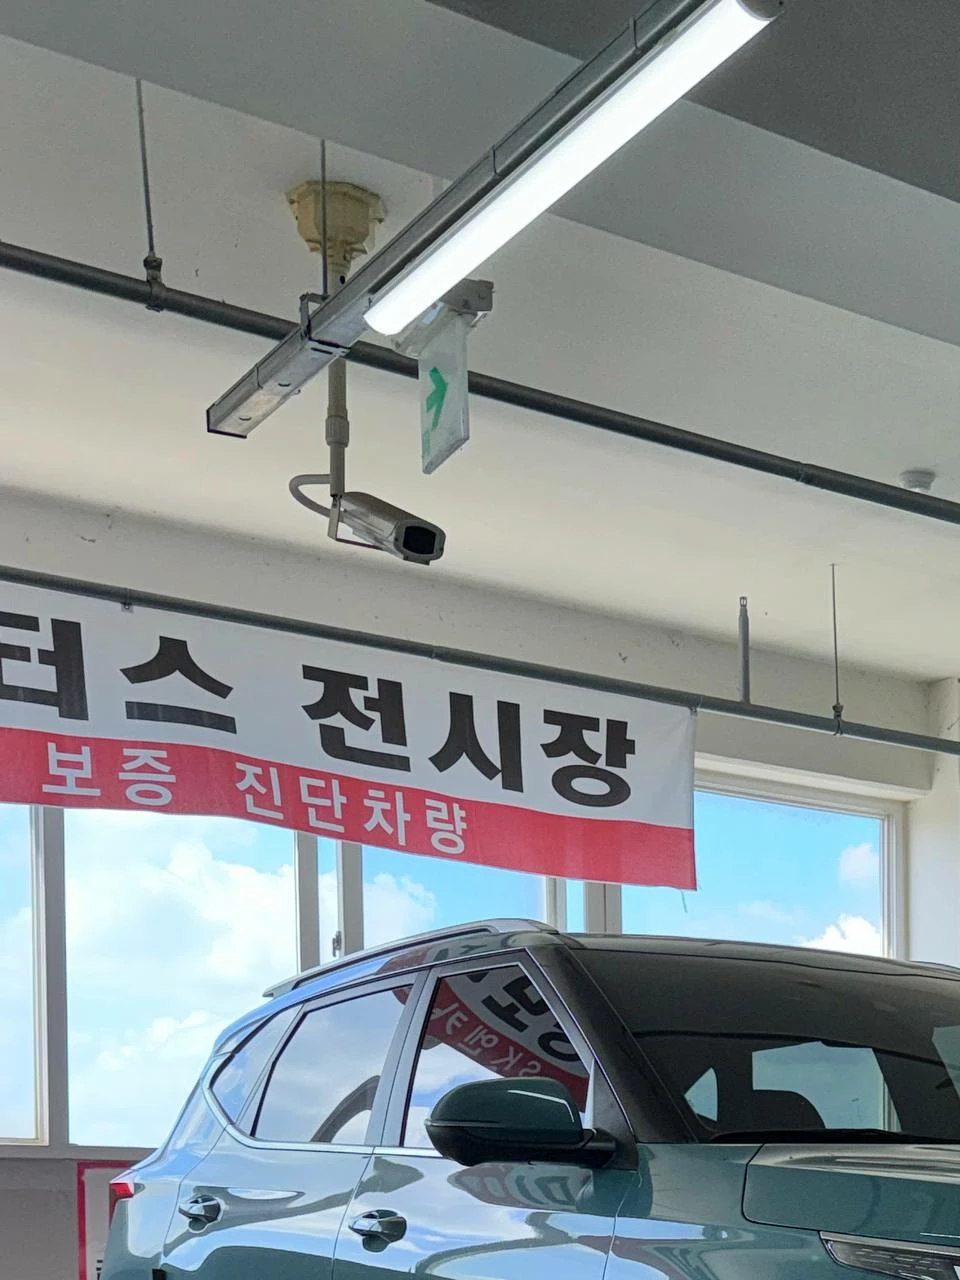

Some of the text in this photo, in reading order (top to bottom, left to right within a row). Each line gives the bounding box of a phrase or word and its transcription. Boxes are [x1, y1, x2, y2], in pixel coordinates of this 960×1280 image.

[0, 610, 636, 808] 터스 전시장
[42, 741, 468, 854] 보증 진단차량
